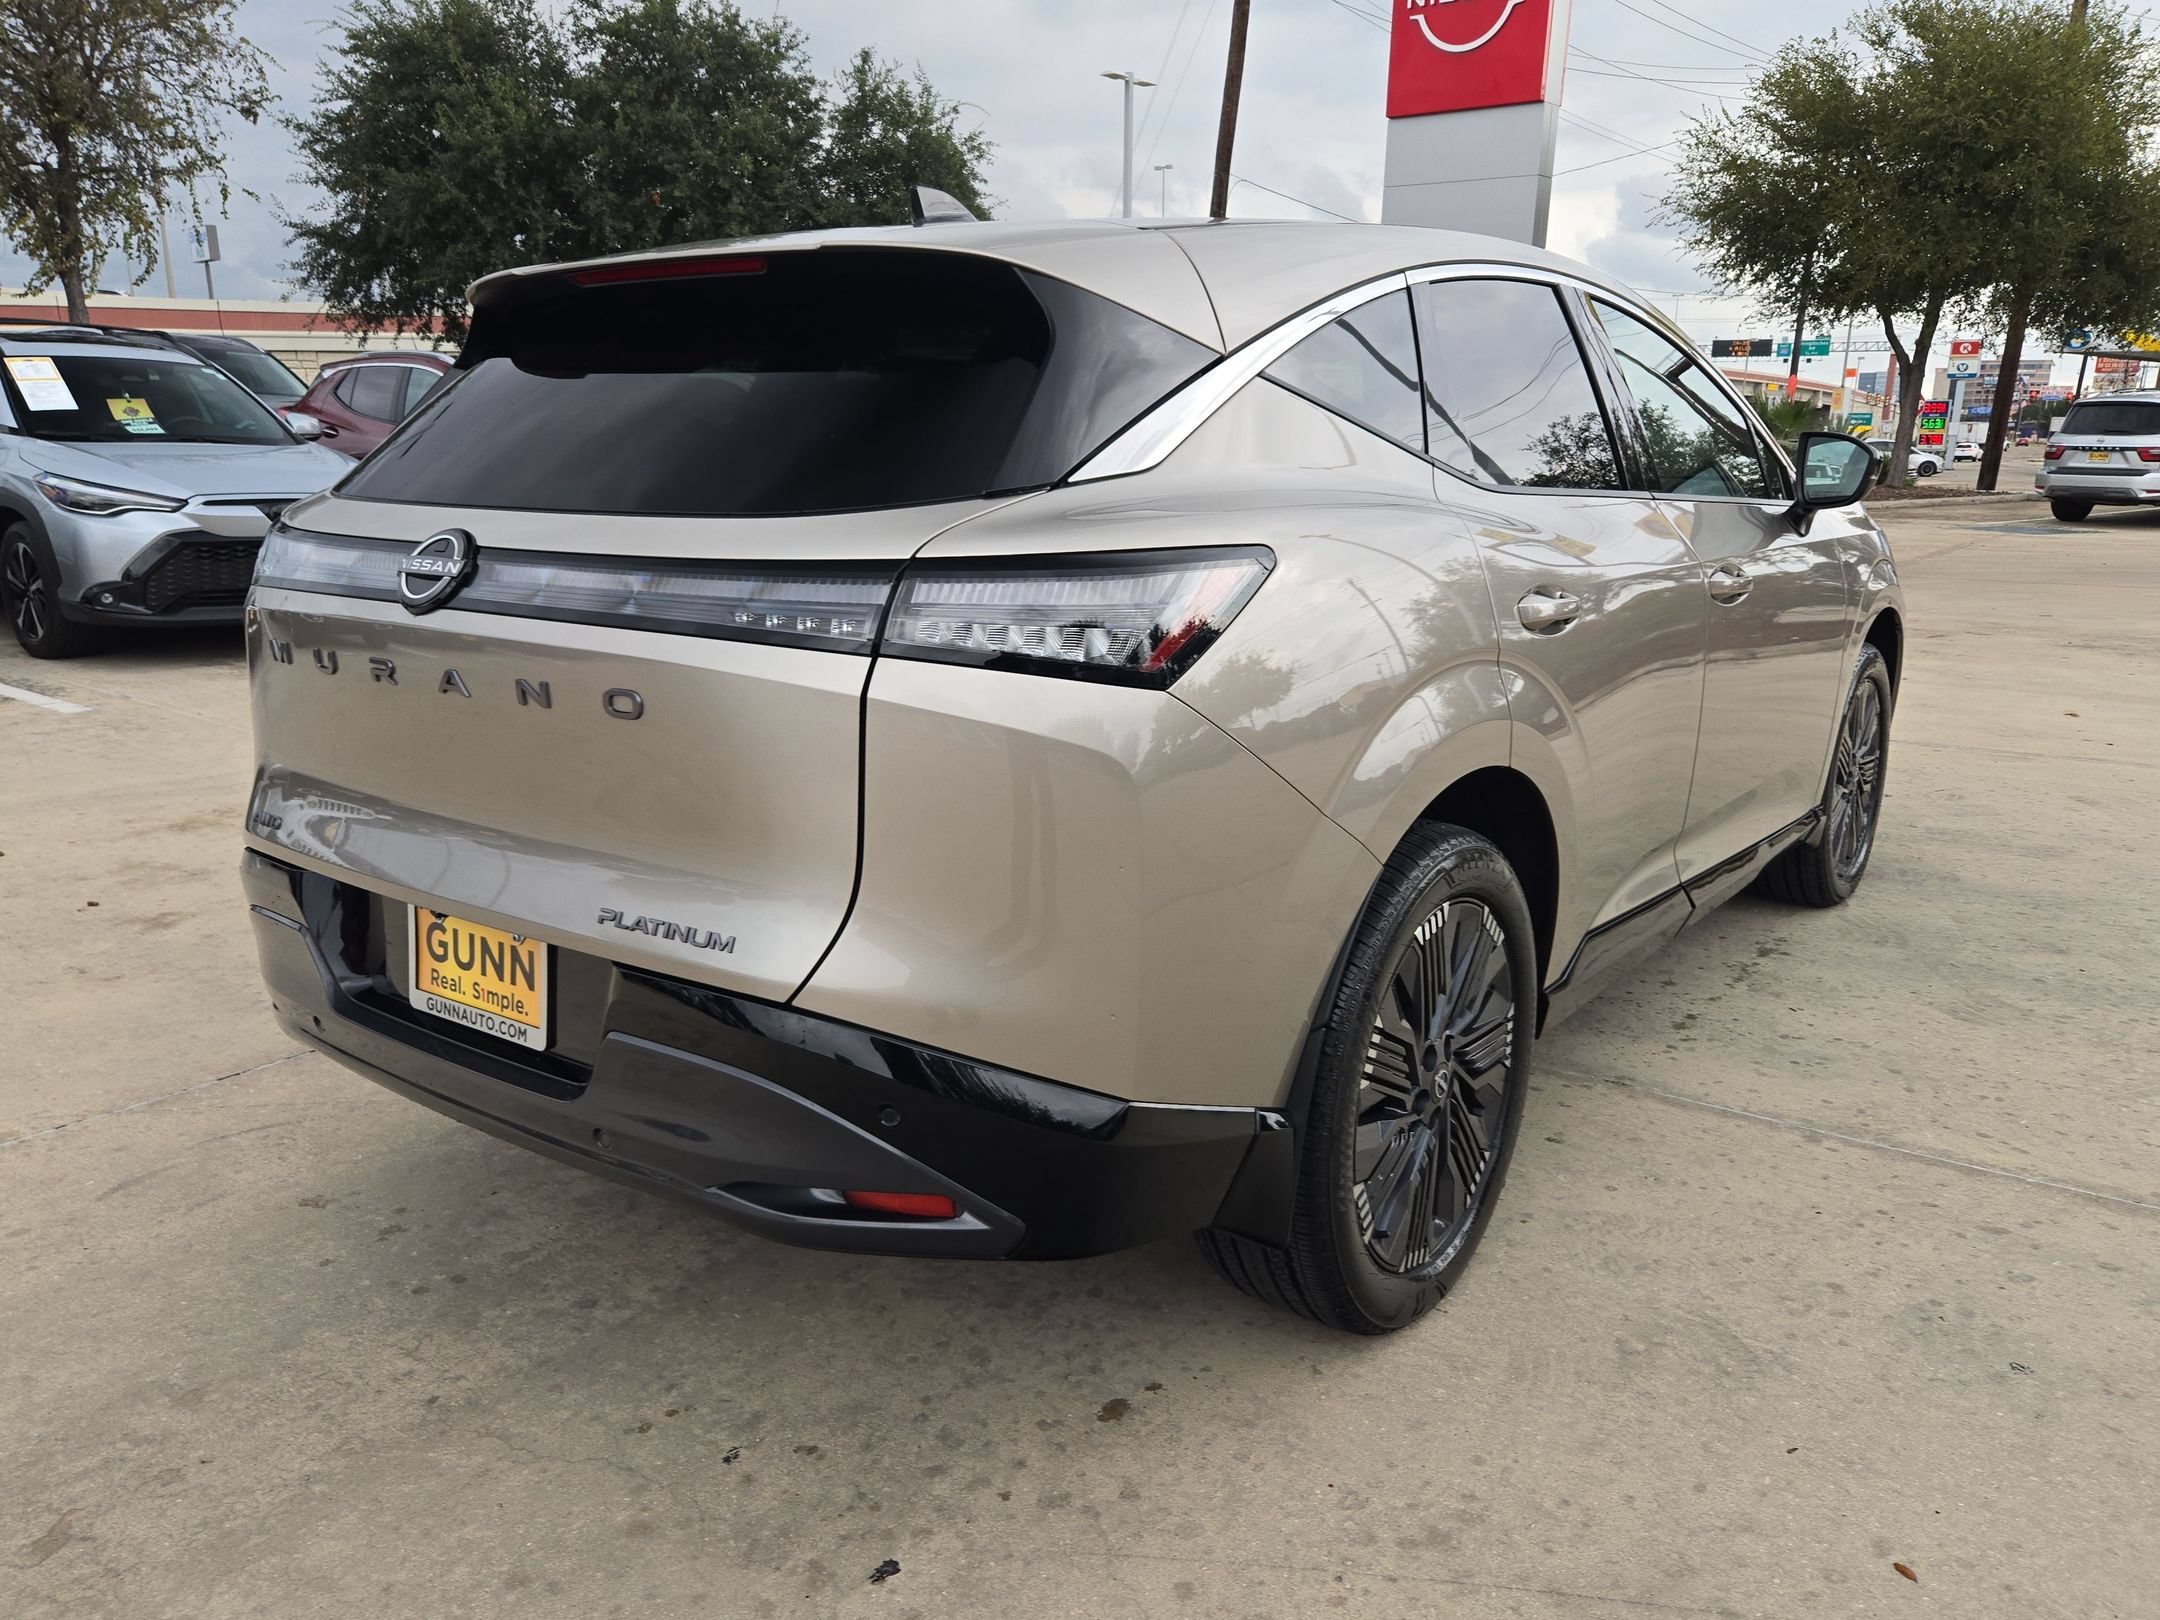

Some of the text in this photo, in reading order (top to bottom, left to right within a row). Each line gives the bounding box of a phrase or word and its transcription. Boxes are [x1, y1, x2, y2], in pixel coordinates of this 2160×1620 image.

[402, 558, 460, 574] NISSAN
[269, 638, 644, 721] MURANO
[597, 907, 737, 954] PLATINUM
[426, 921, 535, 992] GUNN
[431, 967, 467, 996] Real.
[426, 996, 528, 1043] GUNNAUTO.COM
